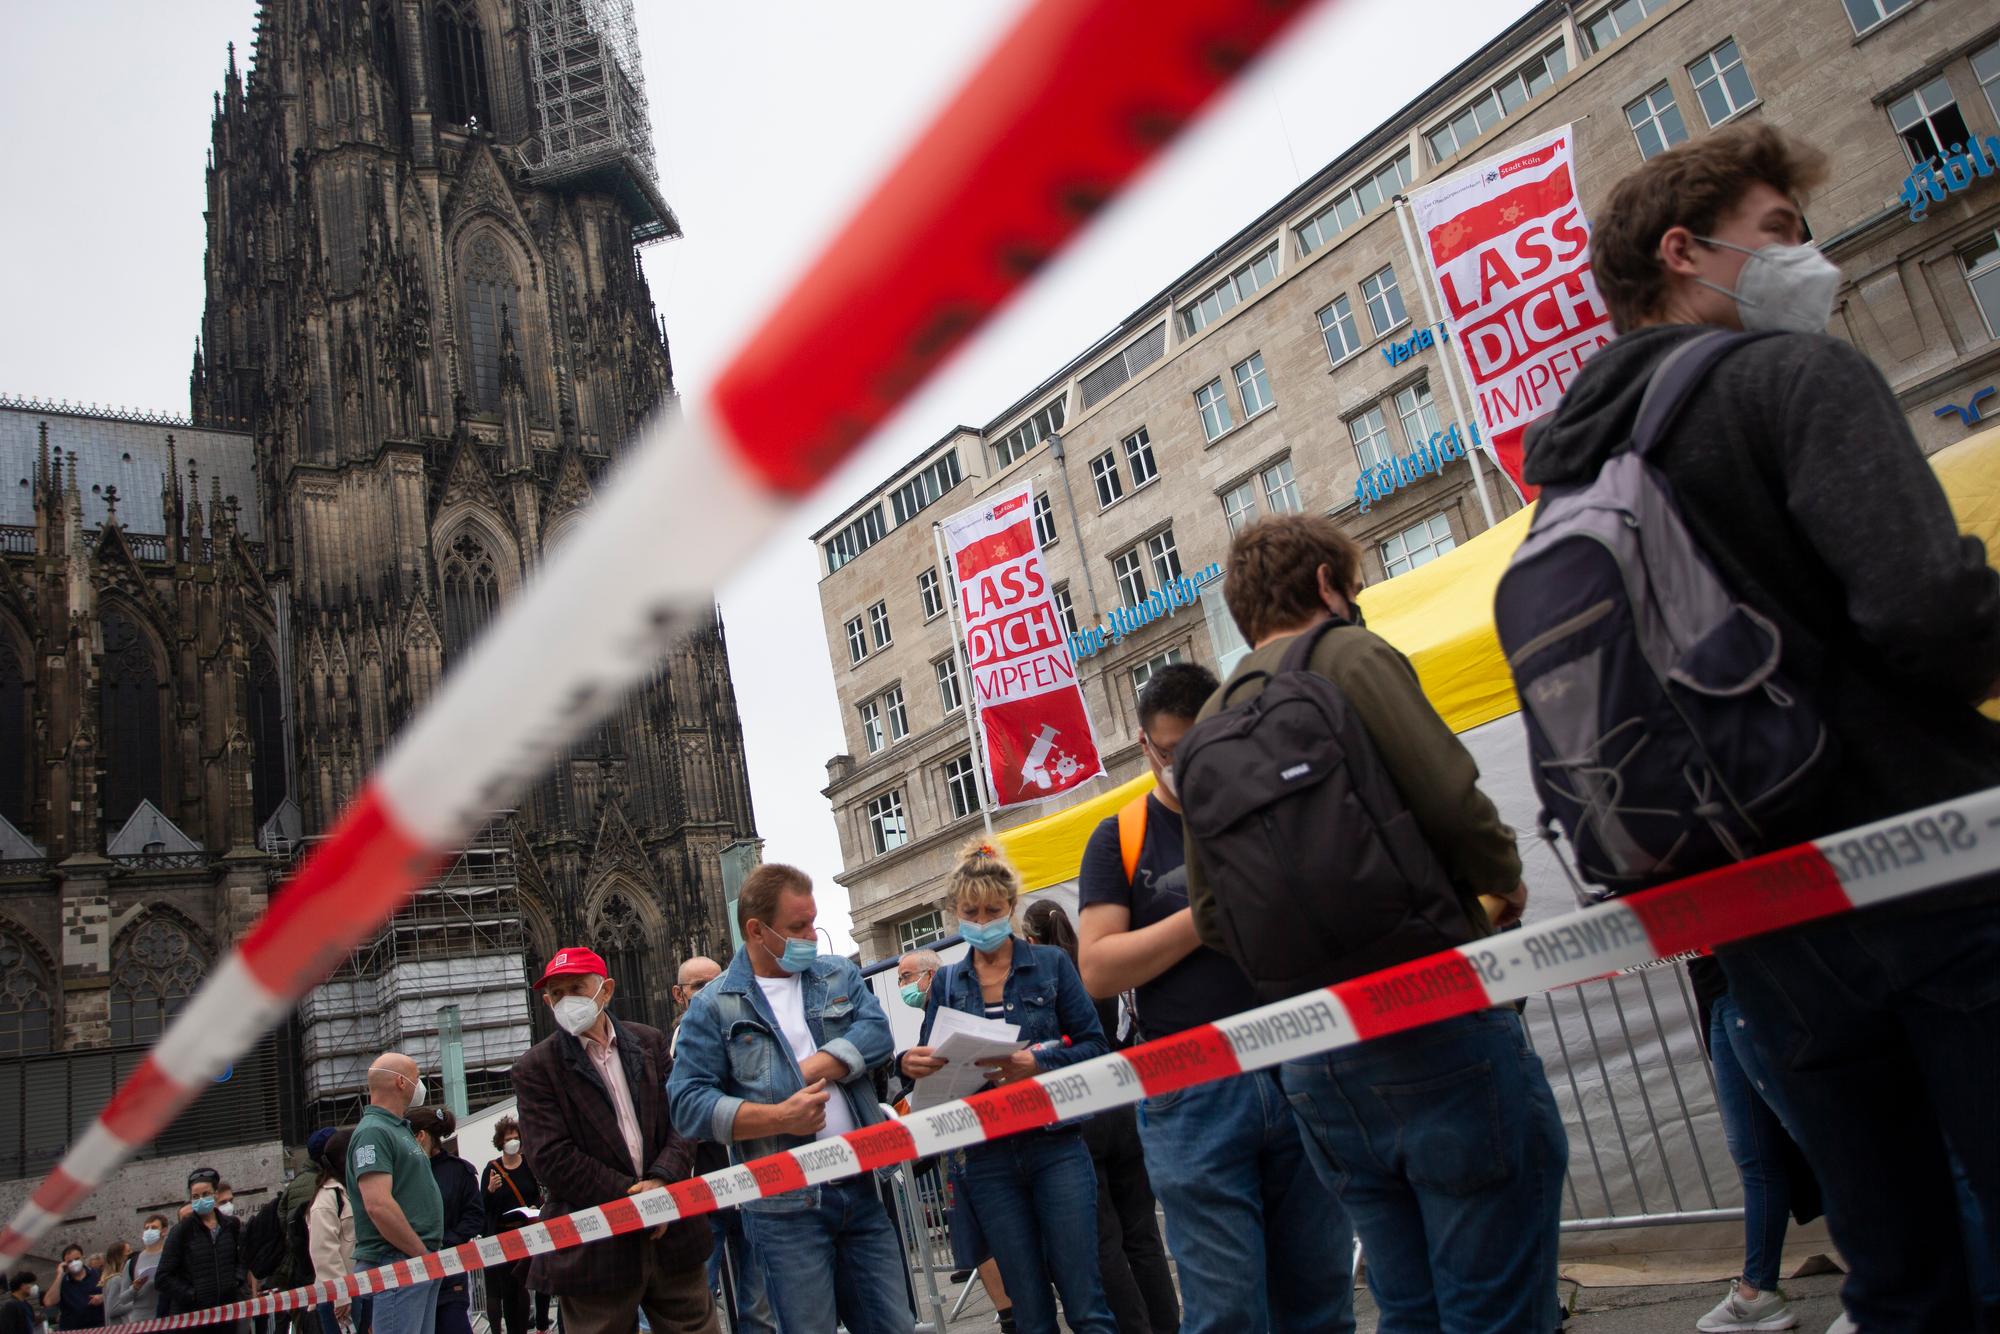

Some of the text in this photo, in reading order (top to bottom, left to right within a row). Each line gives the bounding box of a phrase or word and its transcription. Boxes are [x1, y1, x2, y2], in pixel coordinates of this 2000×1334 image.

[1500, 156, 1541, 176] Stadt Köln
[1439, 207, 1588, 321] LASS
[1467, 269, 1609, 377] DICH
[1479, 335, 1611, 428] IMPFE
[961, 557, 1045, 623] LASS
[971, 607, 1057, 666] DICH
[974, 650, 1074, 703] MPFEN
